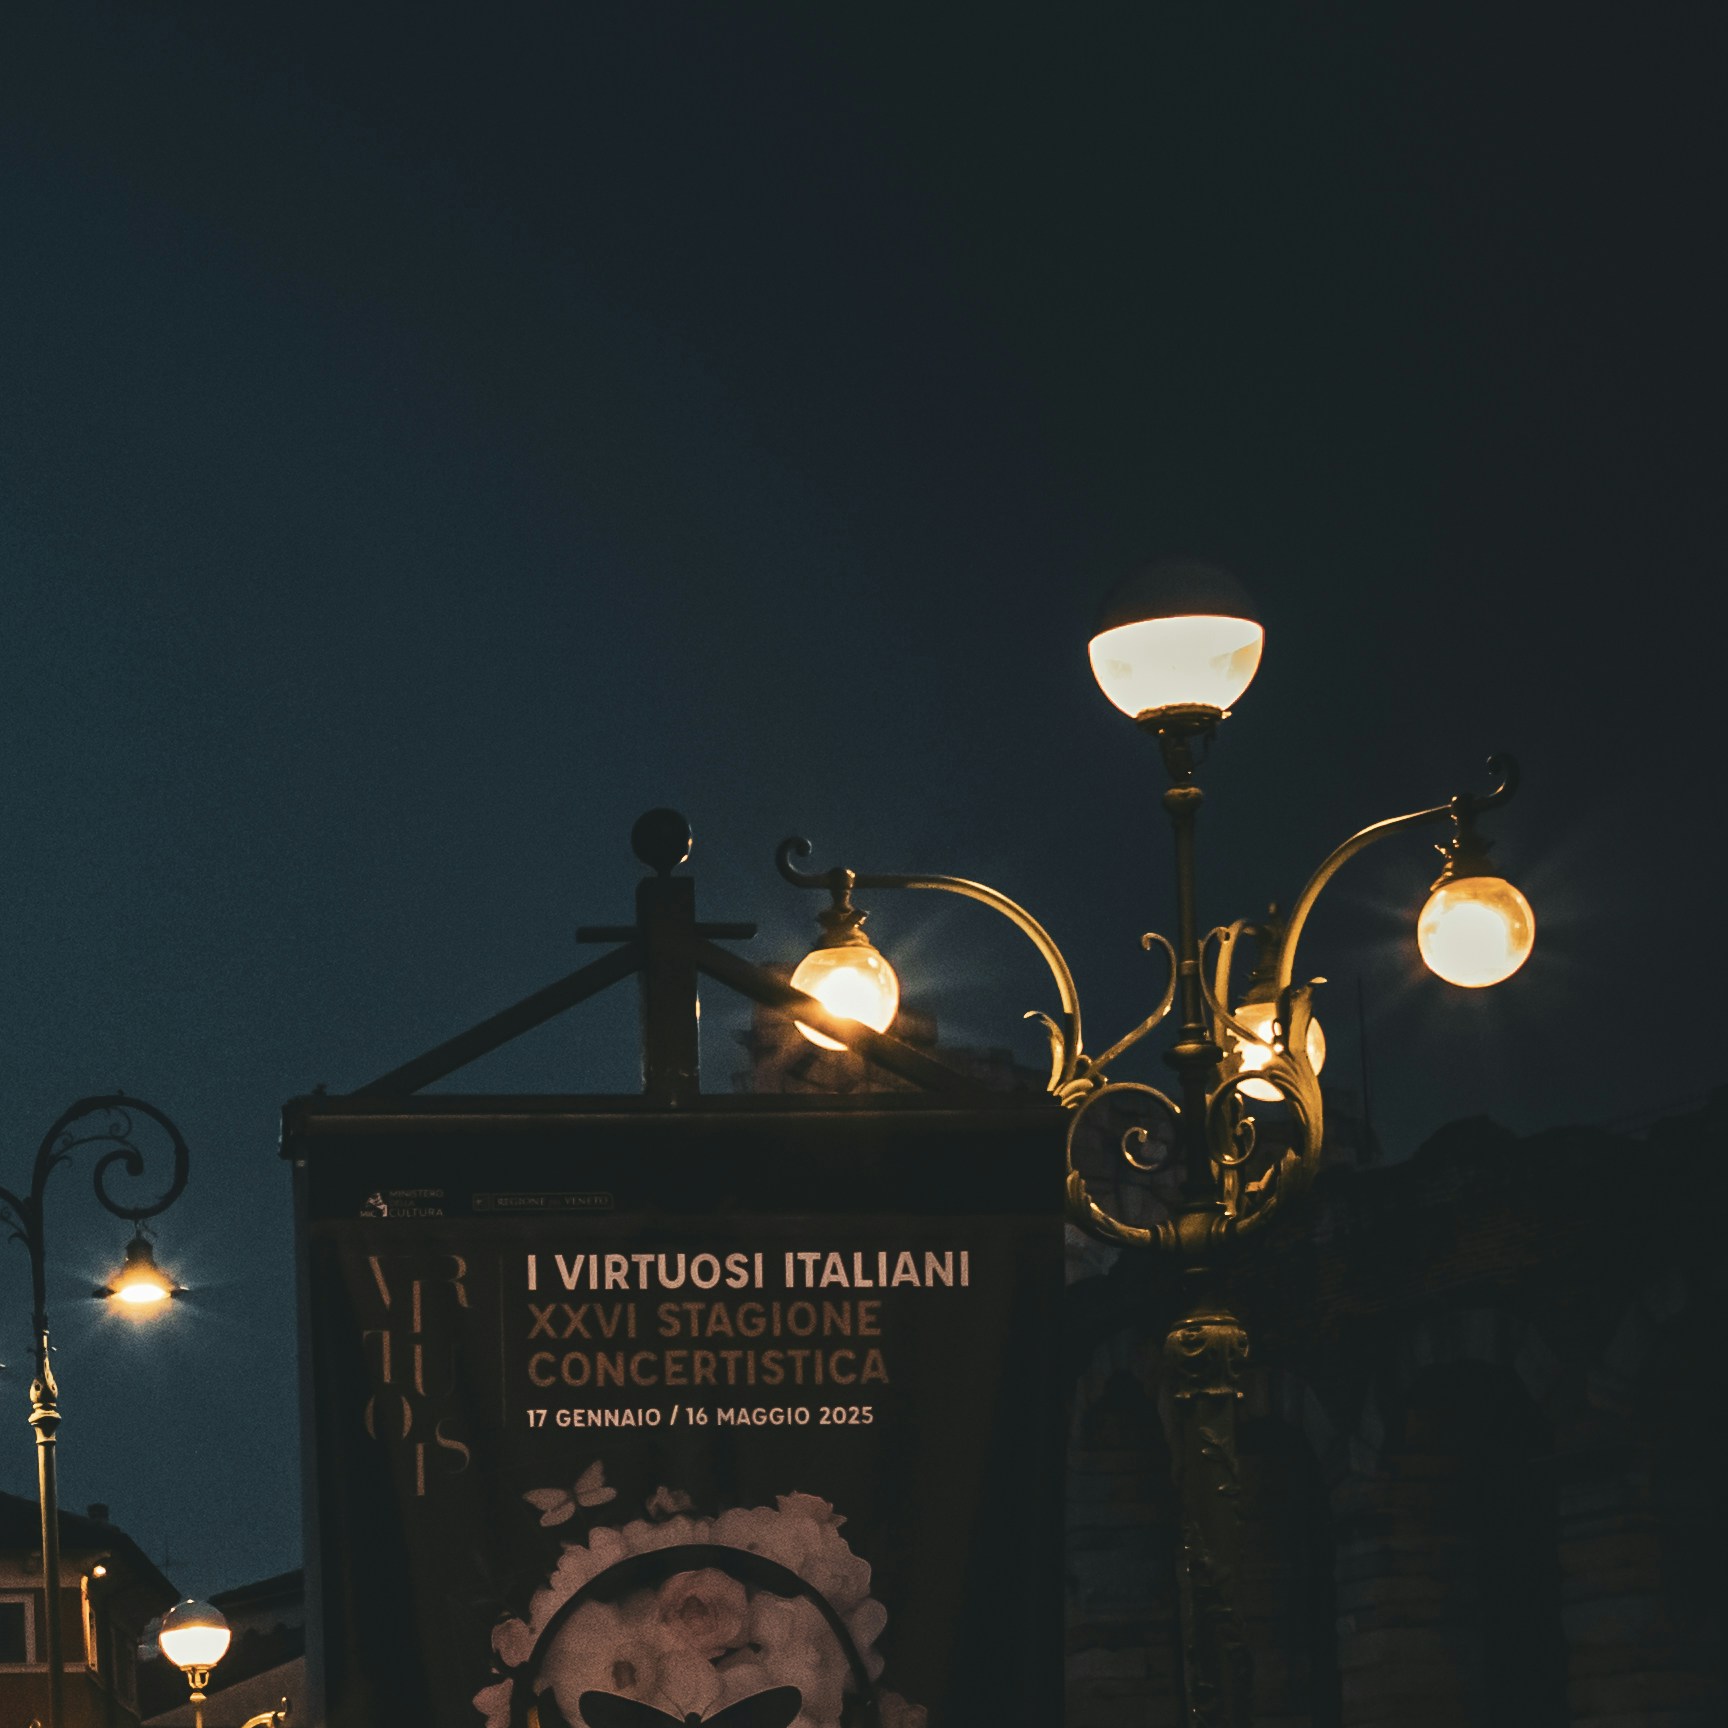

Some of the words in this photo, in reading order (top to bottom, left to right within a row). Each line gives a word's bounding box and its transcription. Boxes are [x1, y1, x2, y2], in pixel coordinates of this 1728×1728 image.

[389, 1189, 445, 1198] MINISTERO
[495, 1196, 545, 1208] REGIONE
[564, 1195, 610, 1207] VENETO
[389, 1207, 444, 1218] CULTURA
[527, 1254, 537, 1291] I
[553, 1252, 765, 1291] VIRTUOSI
[784, 1250, 970, 1290] ITALIANI
[526, 1302, 638, 1340] XXVI
[657, 1300, 882, 1339] STAGIONE
[526, 1349, 890, 1388] CONCERTISTICA
[527, 1409, 547, 1429] 17
[555, 1407, 662, 1429] GENNAIO
[687, 1407, 709, 1428] 16
[716, 1406, 811, 1428] MAGGIO
[820, 1405, 875, 1427] 2025
